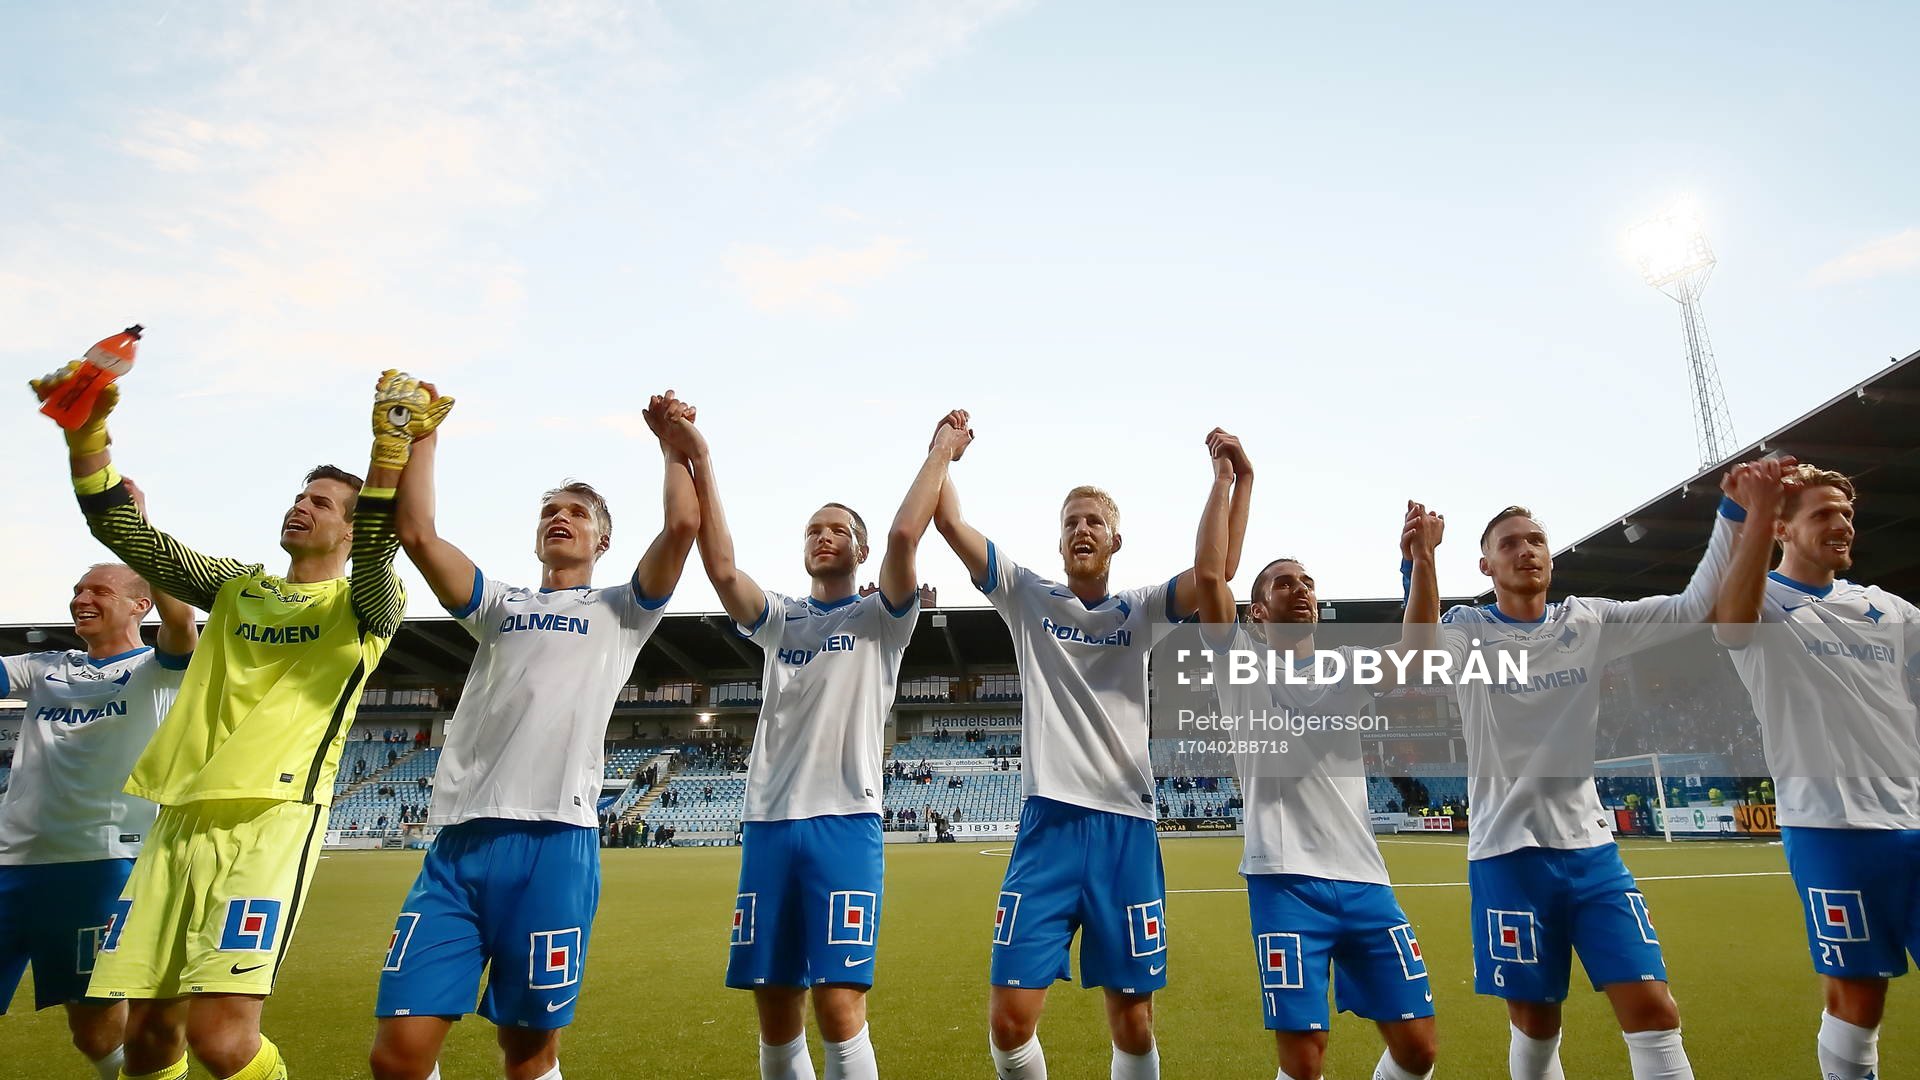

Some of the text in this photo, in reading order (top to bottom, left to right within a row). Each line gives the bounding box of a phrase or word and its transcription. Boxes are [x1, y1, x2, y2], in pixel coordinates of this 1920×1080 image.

[234, 624, 320, 644] OLMEN
[500, 613, 590, 635] OLMEN
[968, 824, 998, 832] 1893
[1819, 942, 1845, 967] 21
[1494, 965, 1504, 987] 6
